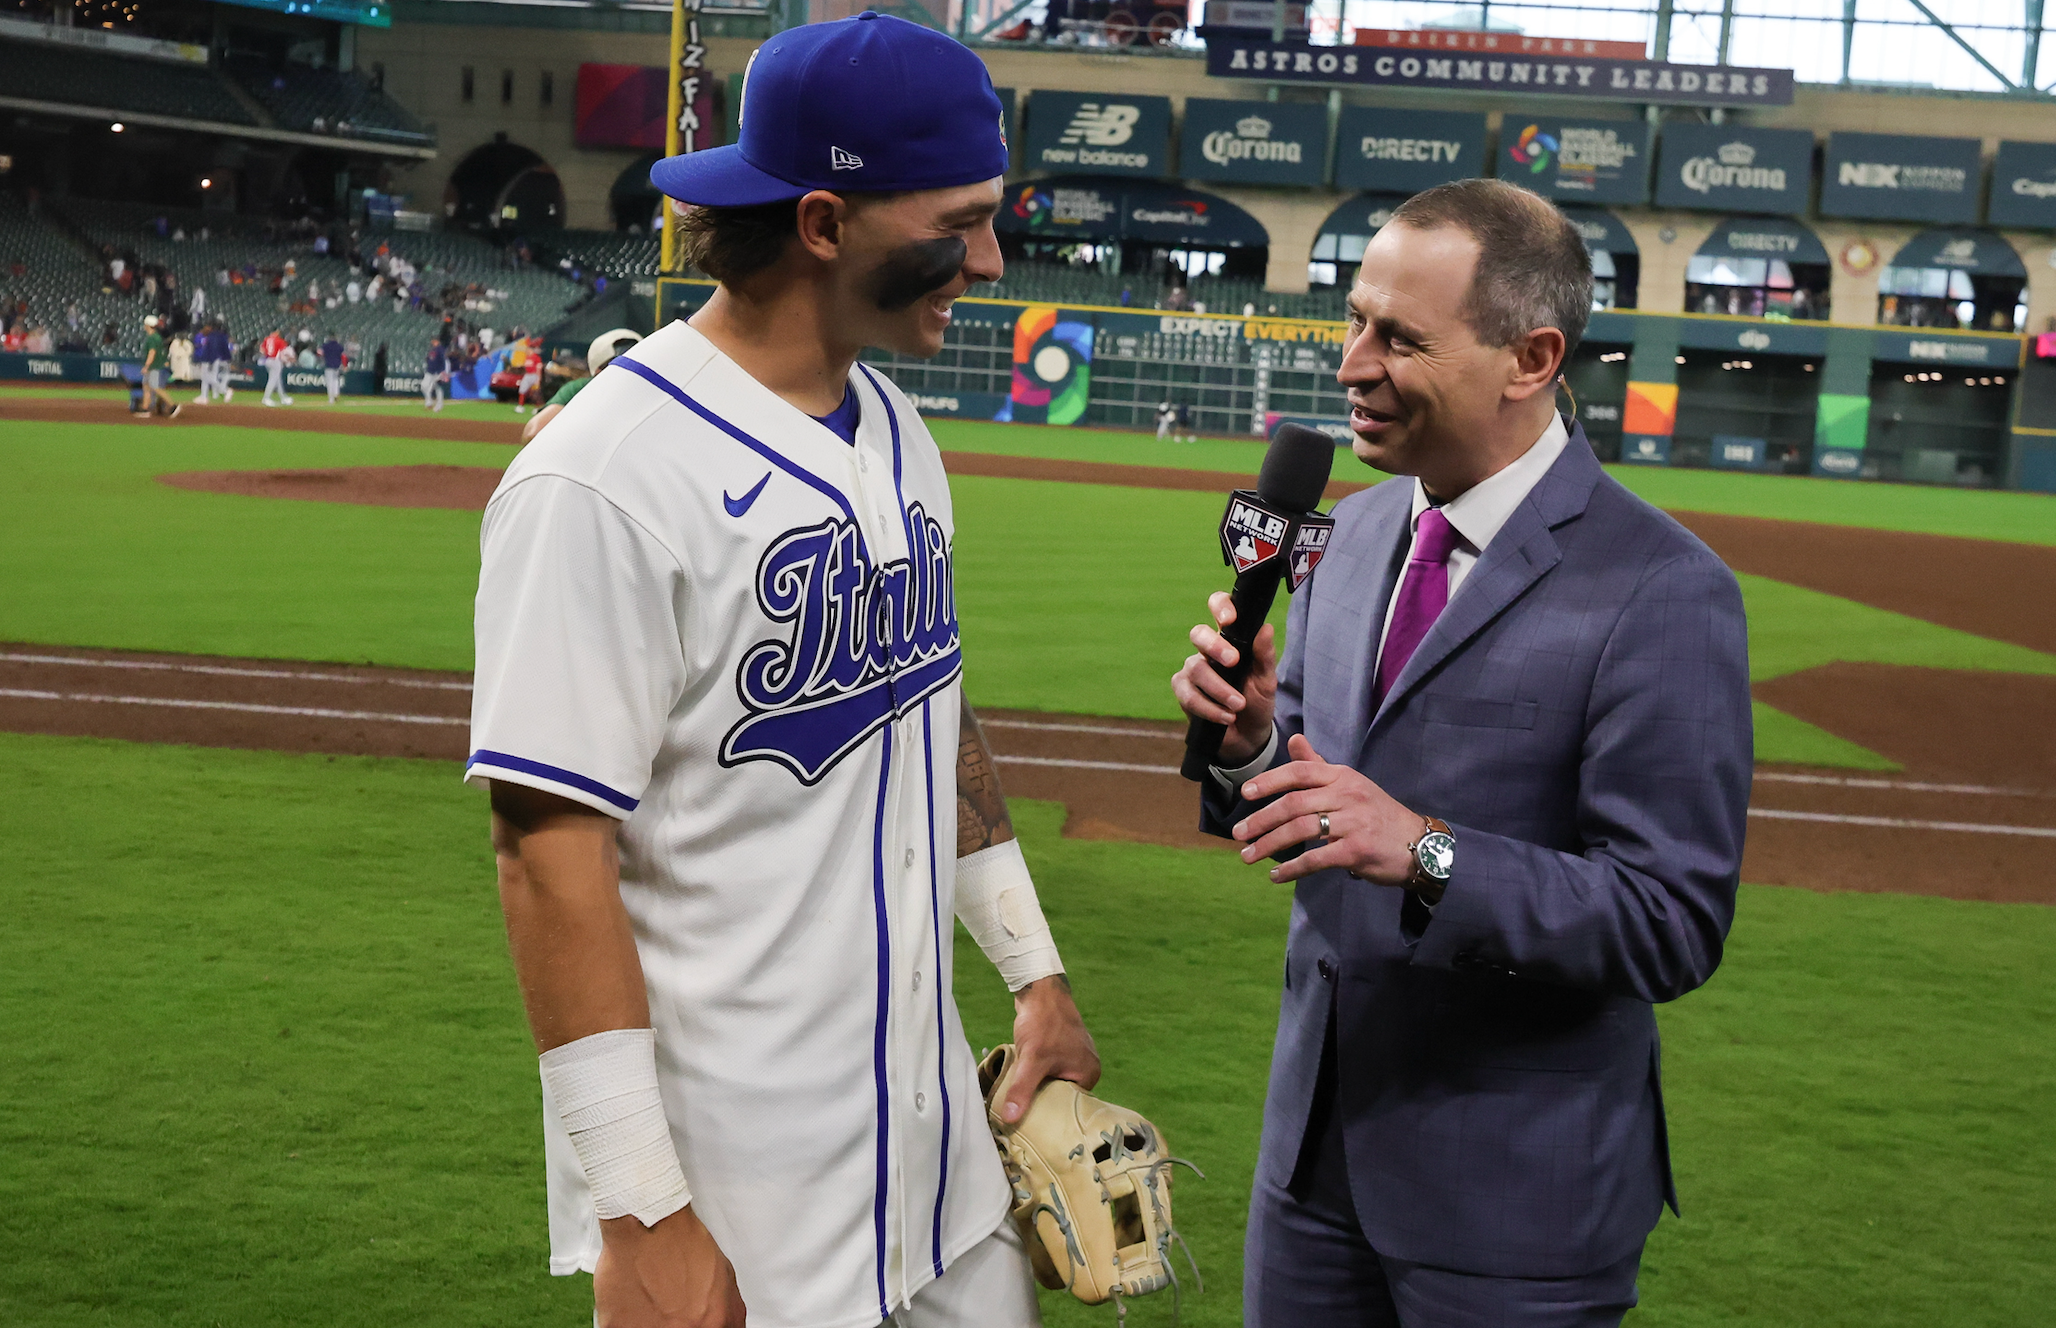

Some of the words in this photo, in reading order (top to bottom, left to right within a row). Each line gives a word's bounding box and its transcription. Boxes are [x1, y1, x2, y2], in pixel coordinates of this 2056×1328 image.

[1230, 49, 1358, 75] ASTROS
[1374, 56, 1596, 87] COMMUNITY
[1610, 67, 1770, 96] LEADERS
[1041, 148, 1077, 163] new
[1079, 148, 1149, 168] balance
[1202, 130, 1302, 167] Corona
[1361, 136, 1461, 163] DIRECTV
[1680, 156, 1787, 194] Corona
[1160, 316, 1242, 337] EXPECT
[1243, 321, 1350, 344] EVERYTHI
[27, 359, 63, 375] TENTIAL
[286, 373, 346, 389] KONAI
[1229, 520, 1278, 546] NETWORK
[1231, 503, 1284, 540] MLB
[1296, 527, 1329, 546] MLB
[736, 500, 961, 712] Itali
